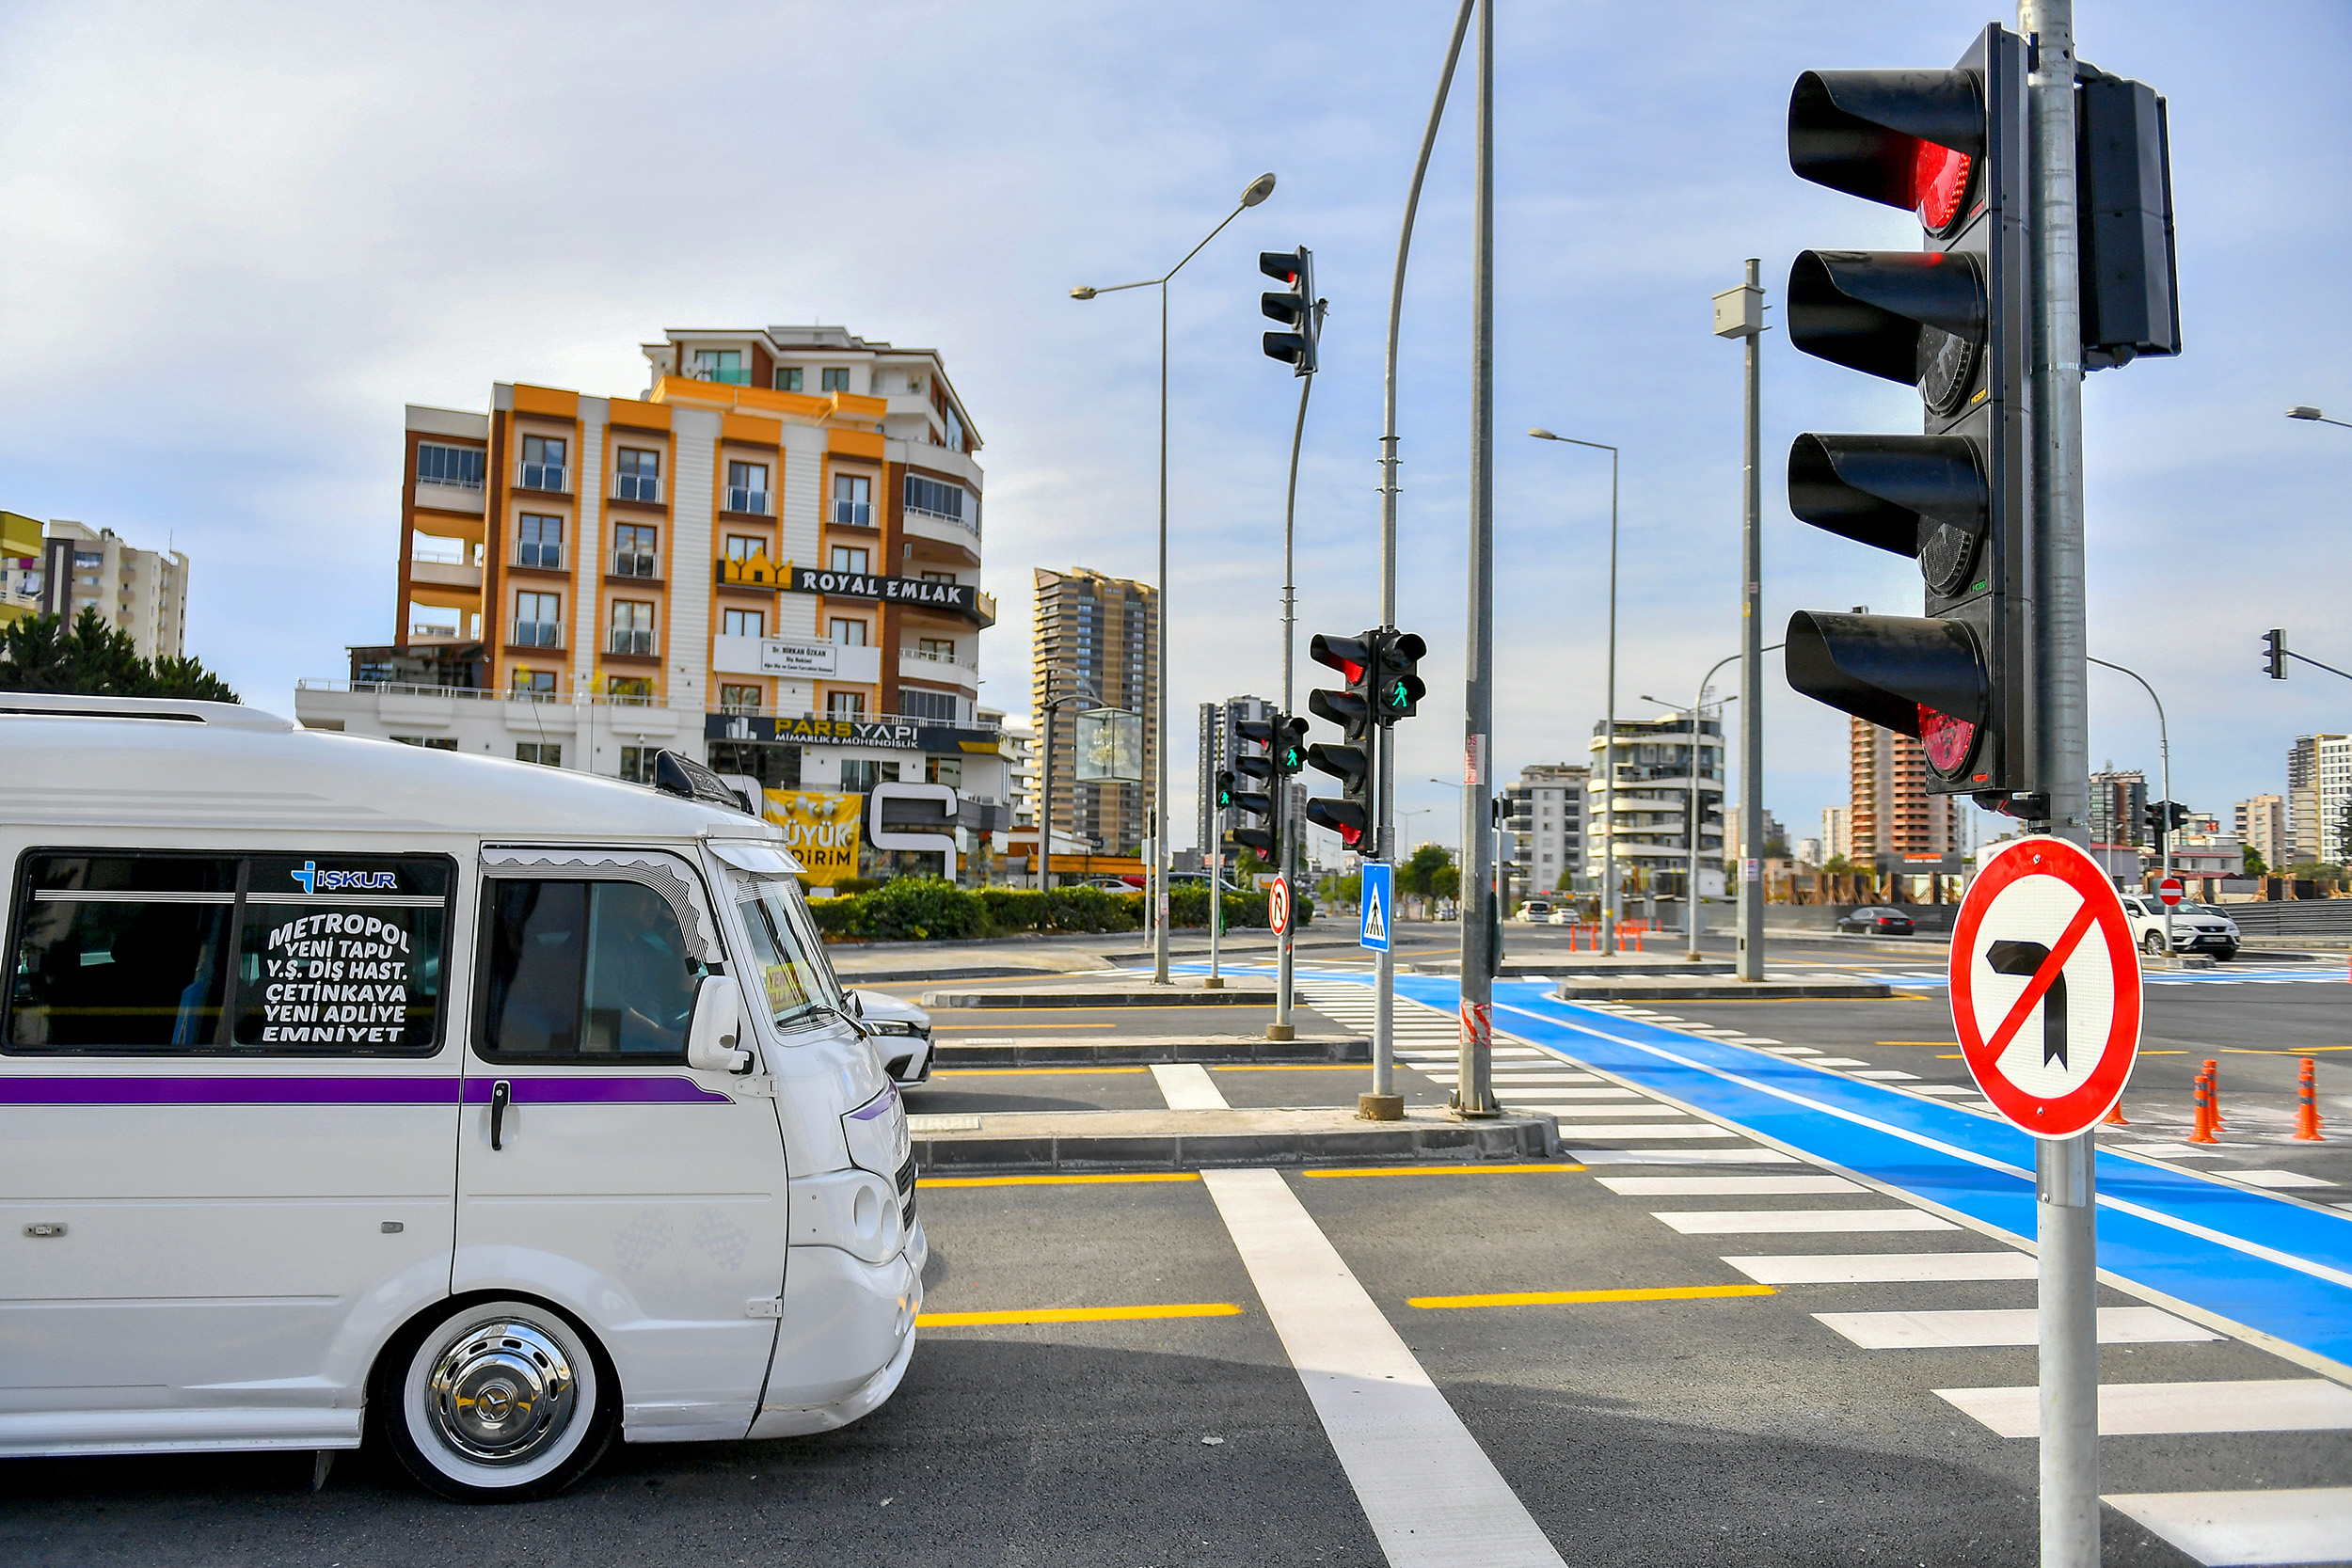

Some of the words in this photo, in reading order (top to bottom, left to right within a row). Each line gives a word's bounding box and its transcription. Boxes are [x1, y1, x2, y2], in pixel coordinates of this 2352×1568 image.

[803, 571, 879, 595] ROYAL
[886, 580, 961, 605] EMLAK
[775, 733, 830, 744] MİMARLIK
[832, 735, 840, 744] &
[842, 736, 918, 749] MÜHENDİSLİK
[786, 818, 851, 847] ÜYÜK
[791, 849, 850, 865] DİRİM
[316, 870, 397, 890] İŞKUR
[268, 913, 410, 954] METROPOL
[285, 937, 333, 958] YENİ
[339, 941, 392, 959] TAPU
[267, 959, 303, 980] Y.Ş.
[309, 958, 344, 981] DİŞ
[349, 961, 408, 980] HAST.
[265, 981, 406, 1004] ÇETİNKAYA
[263, 1003, 319, 1022] YENİ
[323, 1003, 406, 1022] ADLİYE
[262, 1024, 405, 1042] EMNİYET
